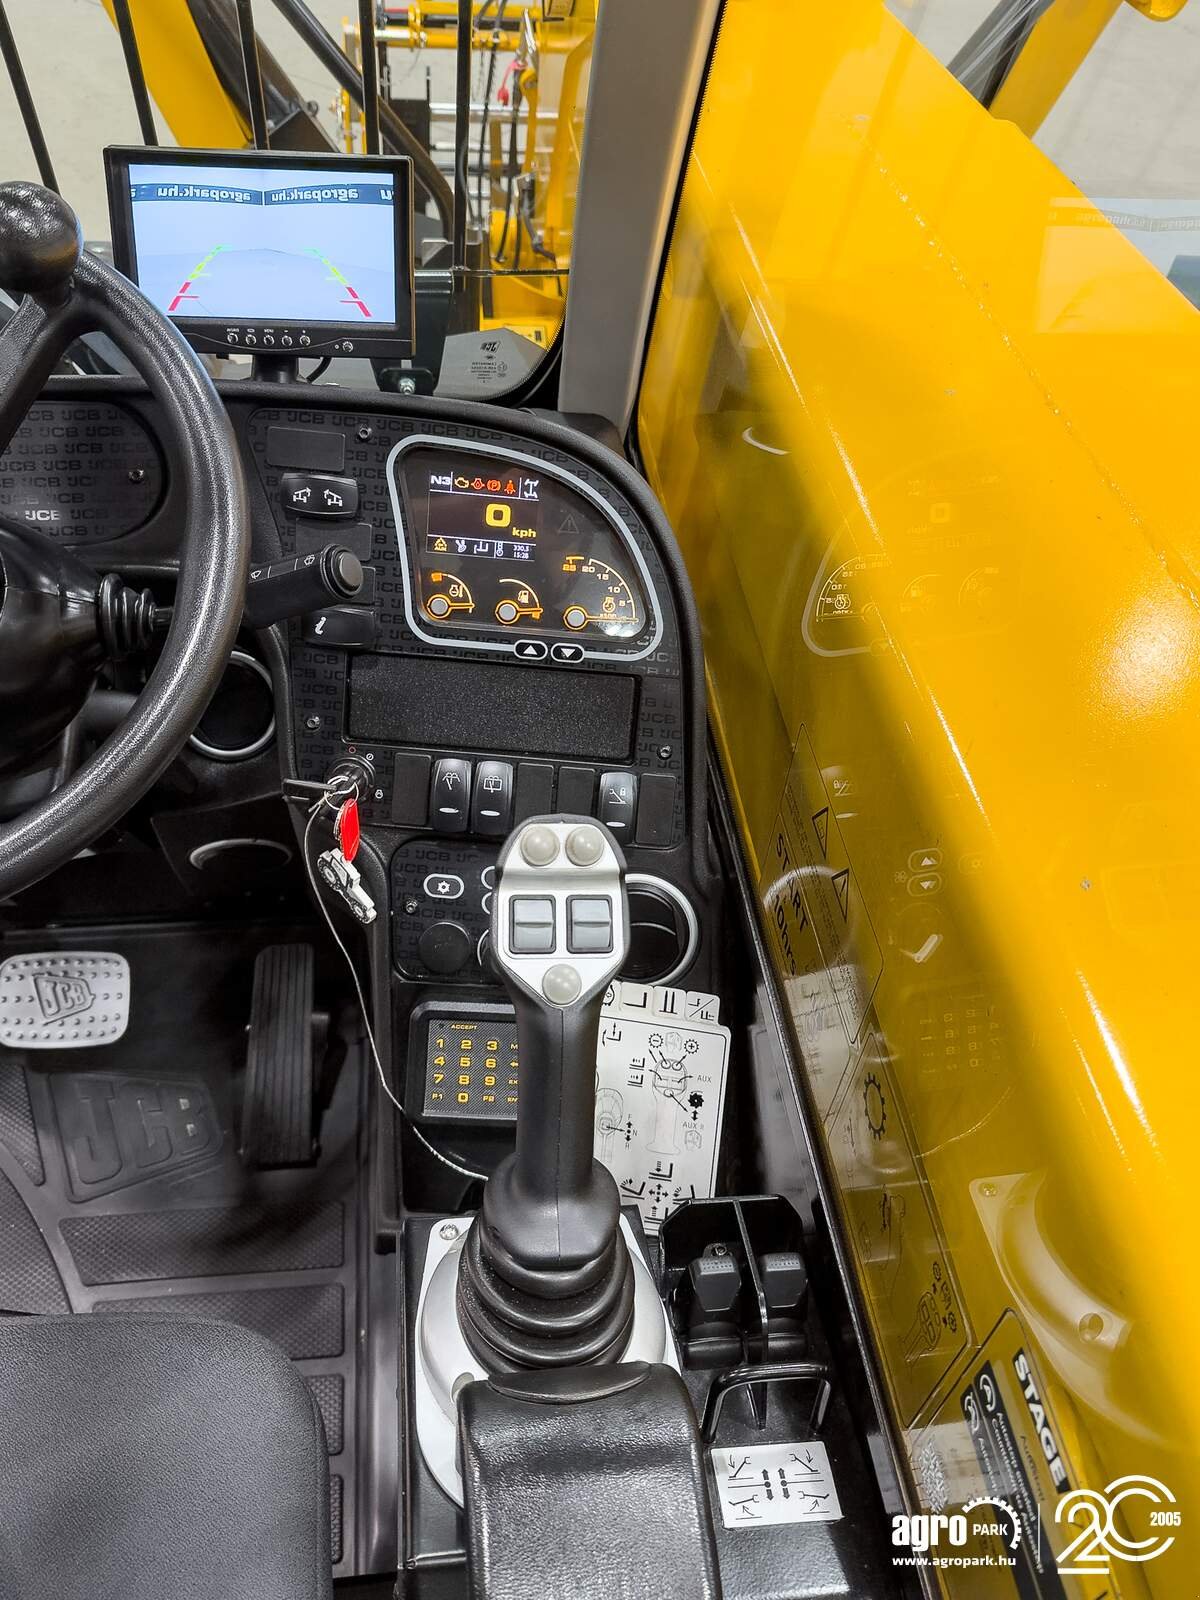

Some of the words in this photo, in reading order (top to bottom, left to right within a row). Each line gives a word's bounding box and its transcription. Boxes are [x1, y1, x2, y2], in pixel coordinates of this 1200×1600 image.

[430, 475, 451, 486] N3
[485, 503, 511, 528] 0
[512, 527, 536, 538] kph
[582, 565, 596, 573] 20
[43, 979, 88, 1017] JCB
[436, 1038, 444, 1048] 1
[461, 1039, 472, 1050] 2
[486, 1040, 498, 1051] 3
[433, 1056, 446, 1067] 4
[459, 1056, 471, 1067] 5
[485, 1058, 497, 1069] 6
[433, 1073, 444, 1084] 7
[458, 1074, 470, 1085] 8
[484, 1075, 496, 1086] 9
[697, 1074, 712, 1083] AUX
[457, 1092, 469, 1104] 0
[682, 1121, 697, 1129] AUX
[1014, 1353, 1067, 1487] STAGE
[996, 1411, 1018, 1471] Autostop
